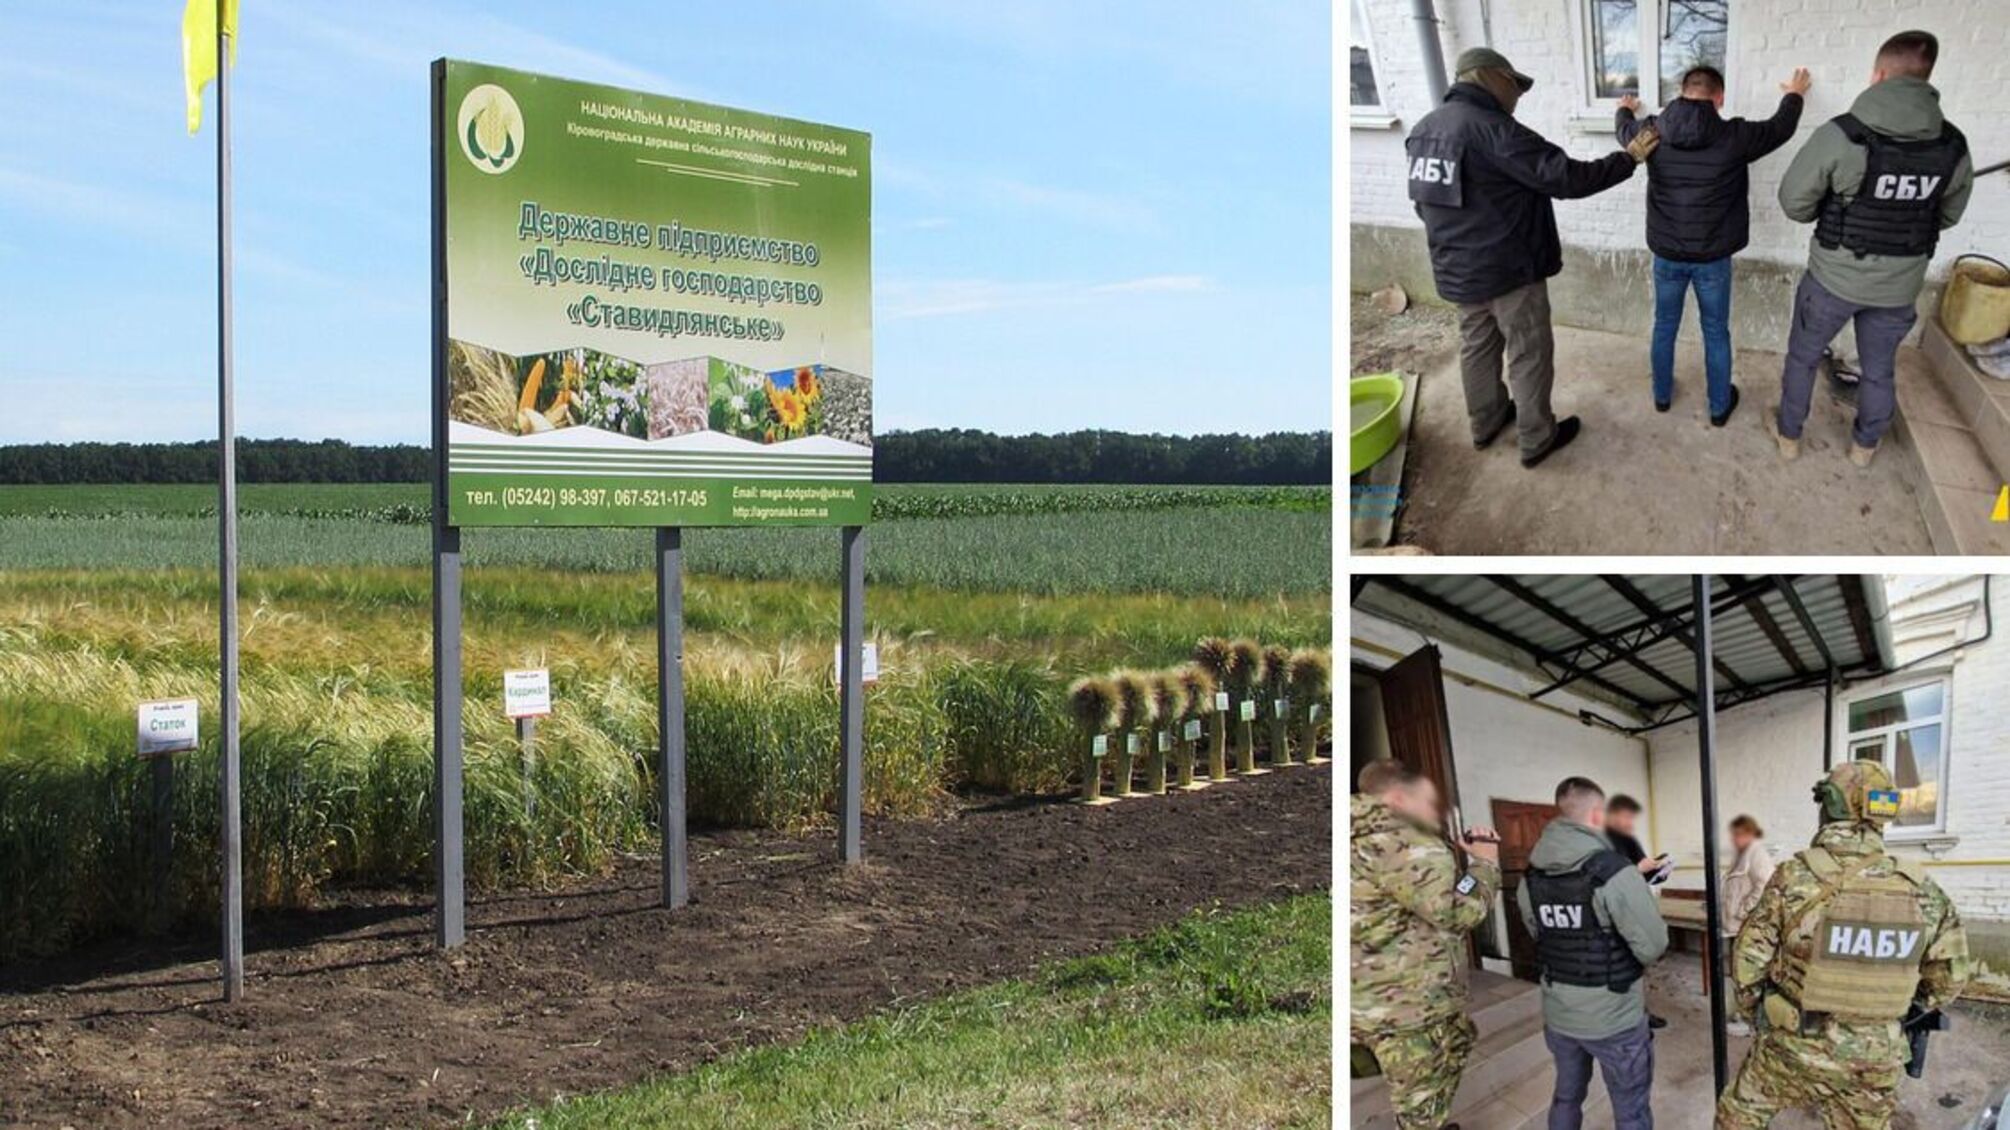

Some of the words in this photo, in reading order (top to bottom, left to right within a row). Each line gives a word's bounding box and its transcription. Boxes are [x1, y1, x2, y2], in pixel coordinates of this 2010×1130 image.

[566, 121, 644, 145] Кіровоградська
[644, 135, 690, 153] державна
[691, 142, 787, 168] сільськогосподарська
[787, 158, 826, 174] дослідна
[827, 164, 859, 178] станція
[580, 100, 664, 128] НАЦІОНАЛЬНА
[666, 114, 721, 137] АКАДЕМІЯ
[723, 124, 777, 146] АГРАРНИХ
[778, 134, 807, 151] НАУК
[805, 138, 848, 157] УКРАЇНИ
[1873, 173, 1942, 201] СБУ
[518, 201, 653, 249] Державне
[656, 219, 821, 267] підприємство
[518, 246, 658, 293] «Дослідне
[661, 267, 824, 308] господарство
[565, 293, 786, 342] «Ставидлянське»
[465, 489, 498, 506] тел.
[502, 487, 556, 510] (05242)
[559, 488, 611, 509] 98-397,
[614, 488, 708, 507] 067-521-17-05
[150, 718, 187, 732] Статок
[1538, 903, 1583, 930] СБУ
[1828, 924, 1920, 960] НАБУ
